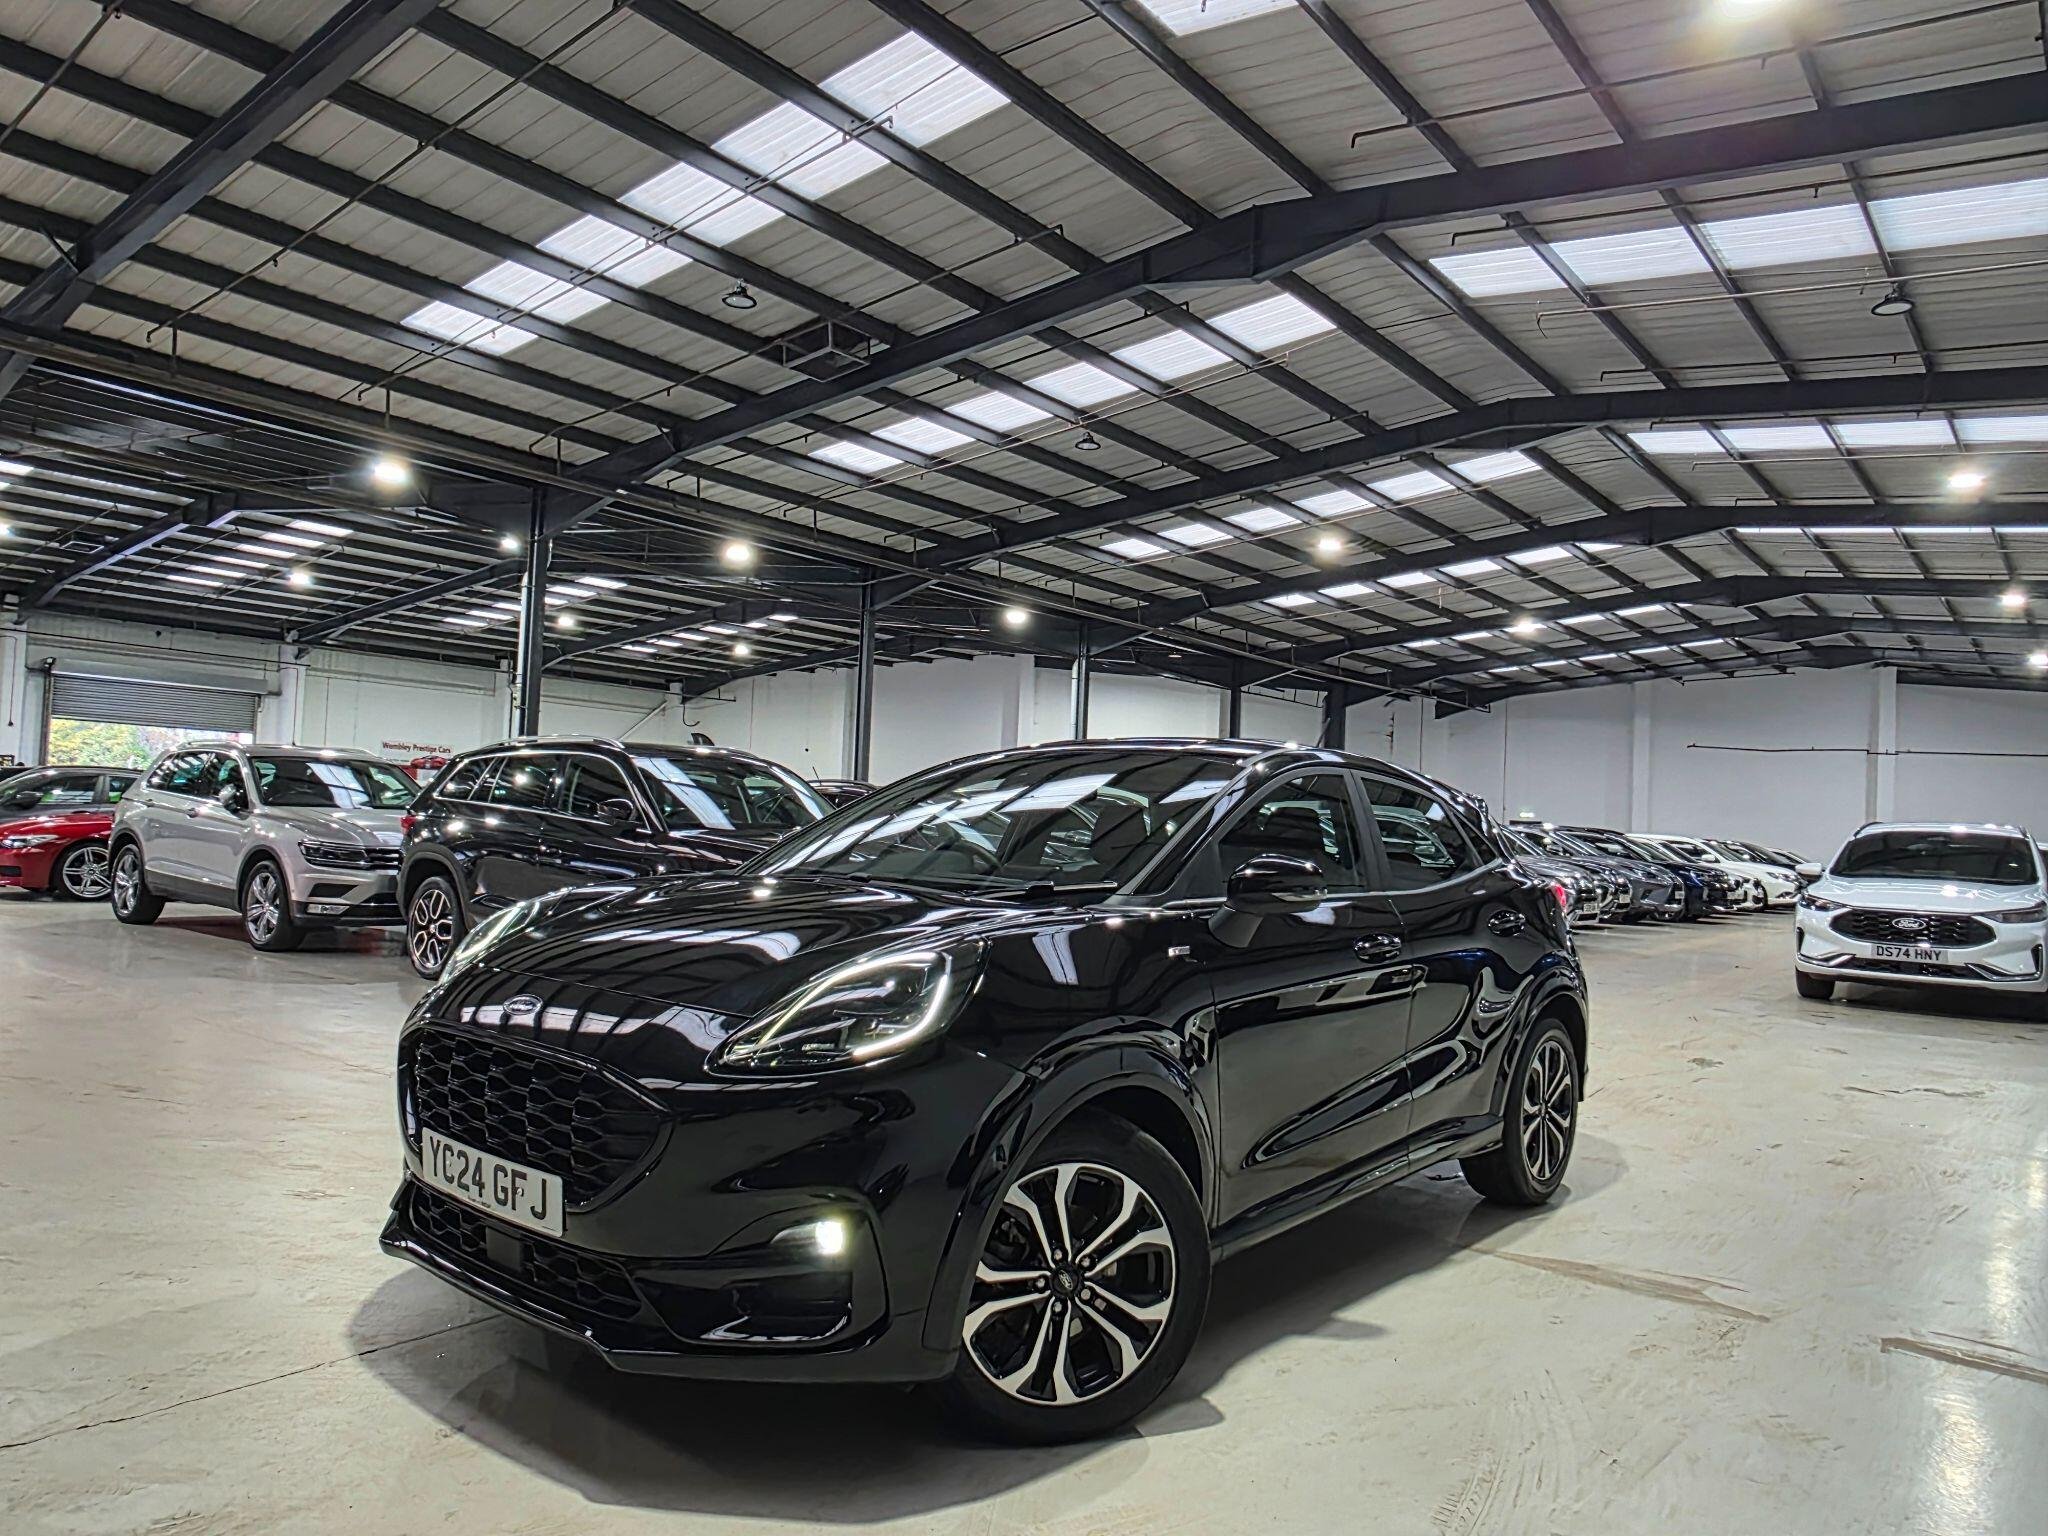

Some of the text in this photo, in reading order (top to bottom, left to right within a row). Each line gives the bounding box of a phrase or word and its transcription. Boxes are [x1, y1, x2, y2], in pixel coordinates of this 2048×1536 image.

[382, 742, 411, 752] Wembley
[412, 744, 437, 754] Prestige
[1876, 946, 1941, 960] DS74 HNY
[430, 1136, 486, 1198] YC24
